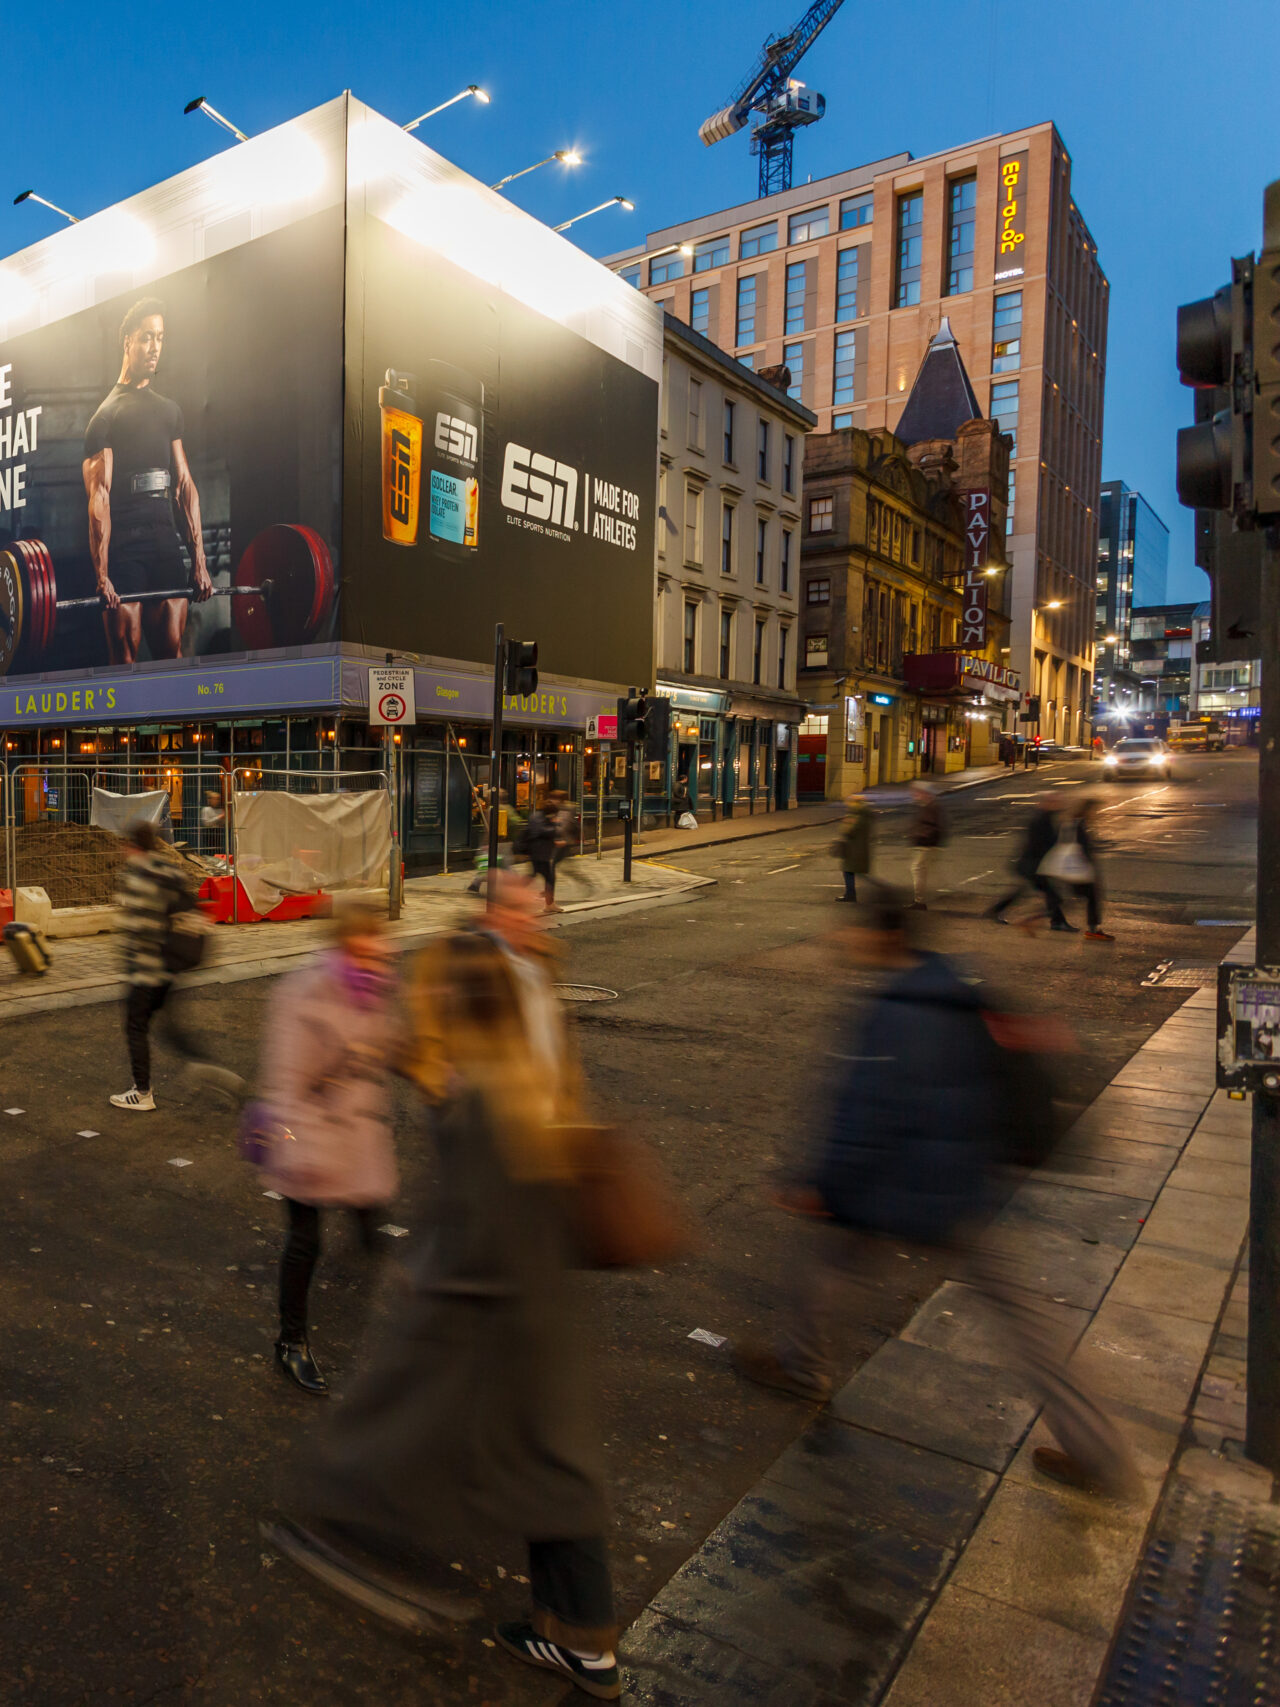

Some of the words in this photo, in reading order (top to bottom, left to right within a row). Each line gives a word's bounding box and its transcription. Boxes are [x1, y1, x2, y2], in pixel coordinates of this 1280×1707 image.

[1001, 160, 1021, 254] maldron
[994, 267, 1025, 280] HOTEL
[594, 477, 620, 513] MADE
[622, 489, 640, 520] FOR
[506, 514, 522, 528] ELITE
[523, 520, 544, 534] SPORTS
[545, 527, 571, 542] NUTRITION
[593, 511, 637, 551] ATHLETES
[962, 493, 988, 643] PAVILION
[197, 684, 212, 696] No.
[214, 682, 224, 694] 76
[379, 682, 405, 690] ZONE
[436, 685, 459, 700] Glasgow
[15, 687, 116, 715] LAUDER'S
[502, 692, 567, 717] LAUDER'S
